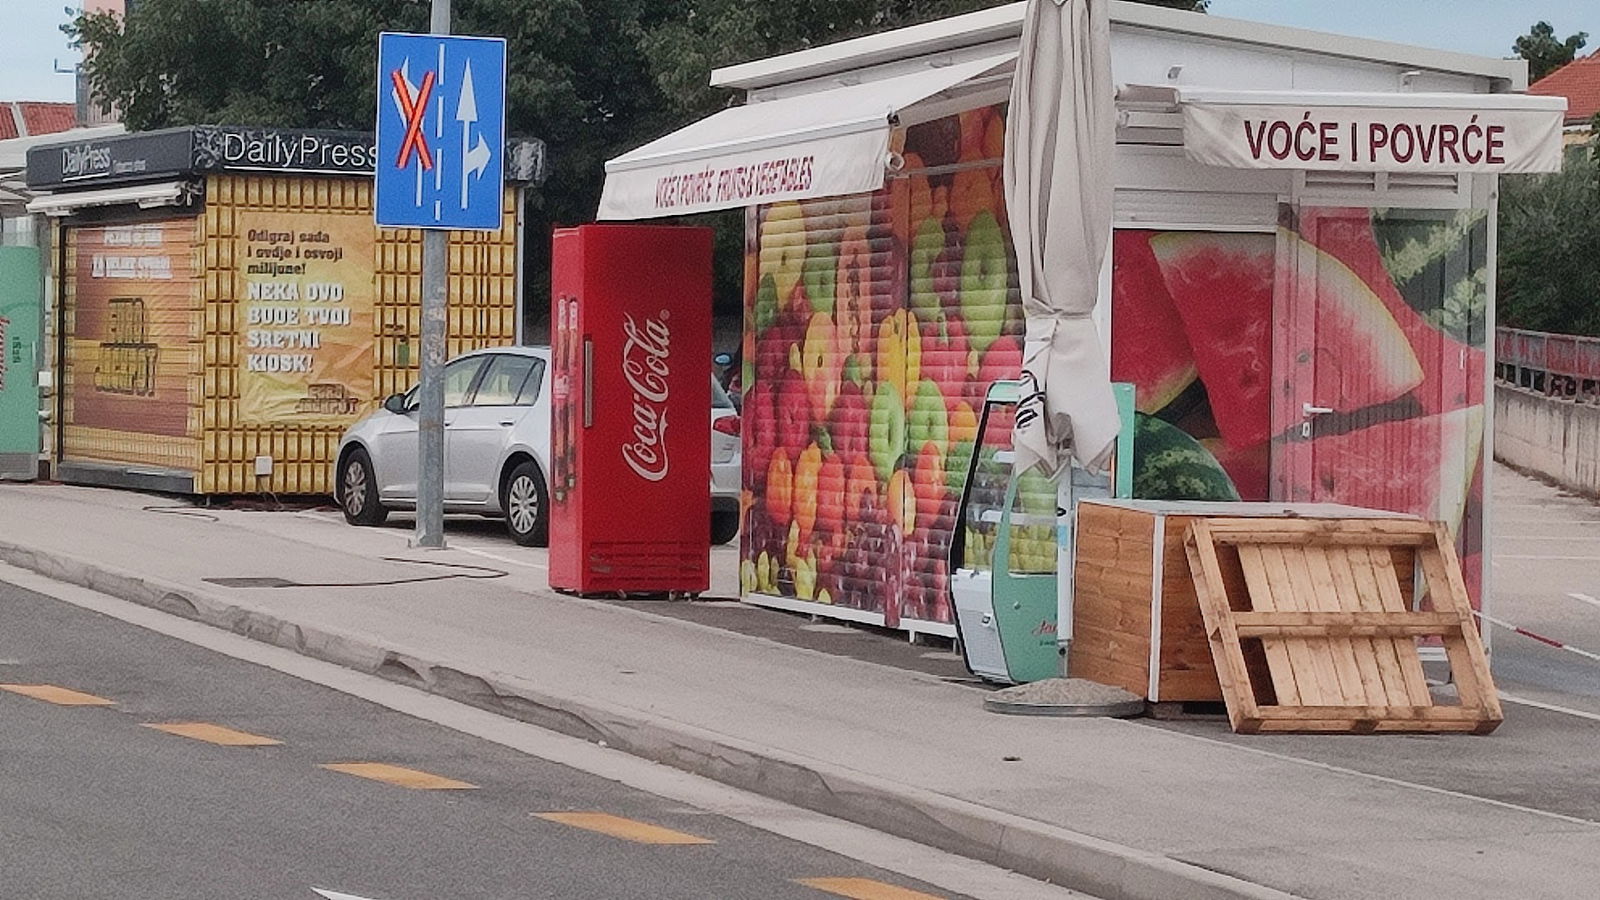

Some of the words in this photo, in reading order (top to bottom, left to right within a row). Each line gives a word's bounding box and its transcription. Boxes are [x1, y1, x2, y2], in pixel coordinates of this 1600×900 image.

[1244, 112, 1339, 161] VOĆE
[1350, 122, 1359, 162] I
[1369, 114, 1506, 165] POVRĆE
[247, 229, 295, 245] Odigraj
[299, 231, 330, 243] sada
[256, 246, 292, 261] ovdje
[304, 247, 343, 263] osvoji
[247, 282, 300, 301] NEKA
[306, 283, 344, 302] OVO
[247, 306, 300, 326] BUDE
[247, 329, 321, 349] SRETNI
[247, 354, 314, 373] KIOSK!
